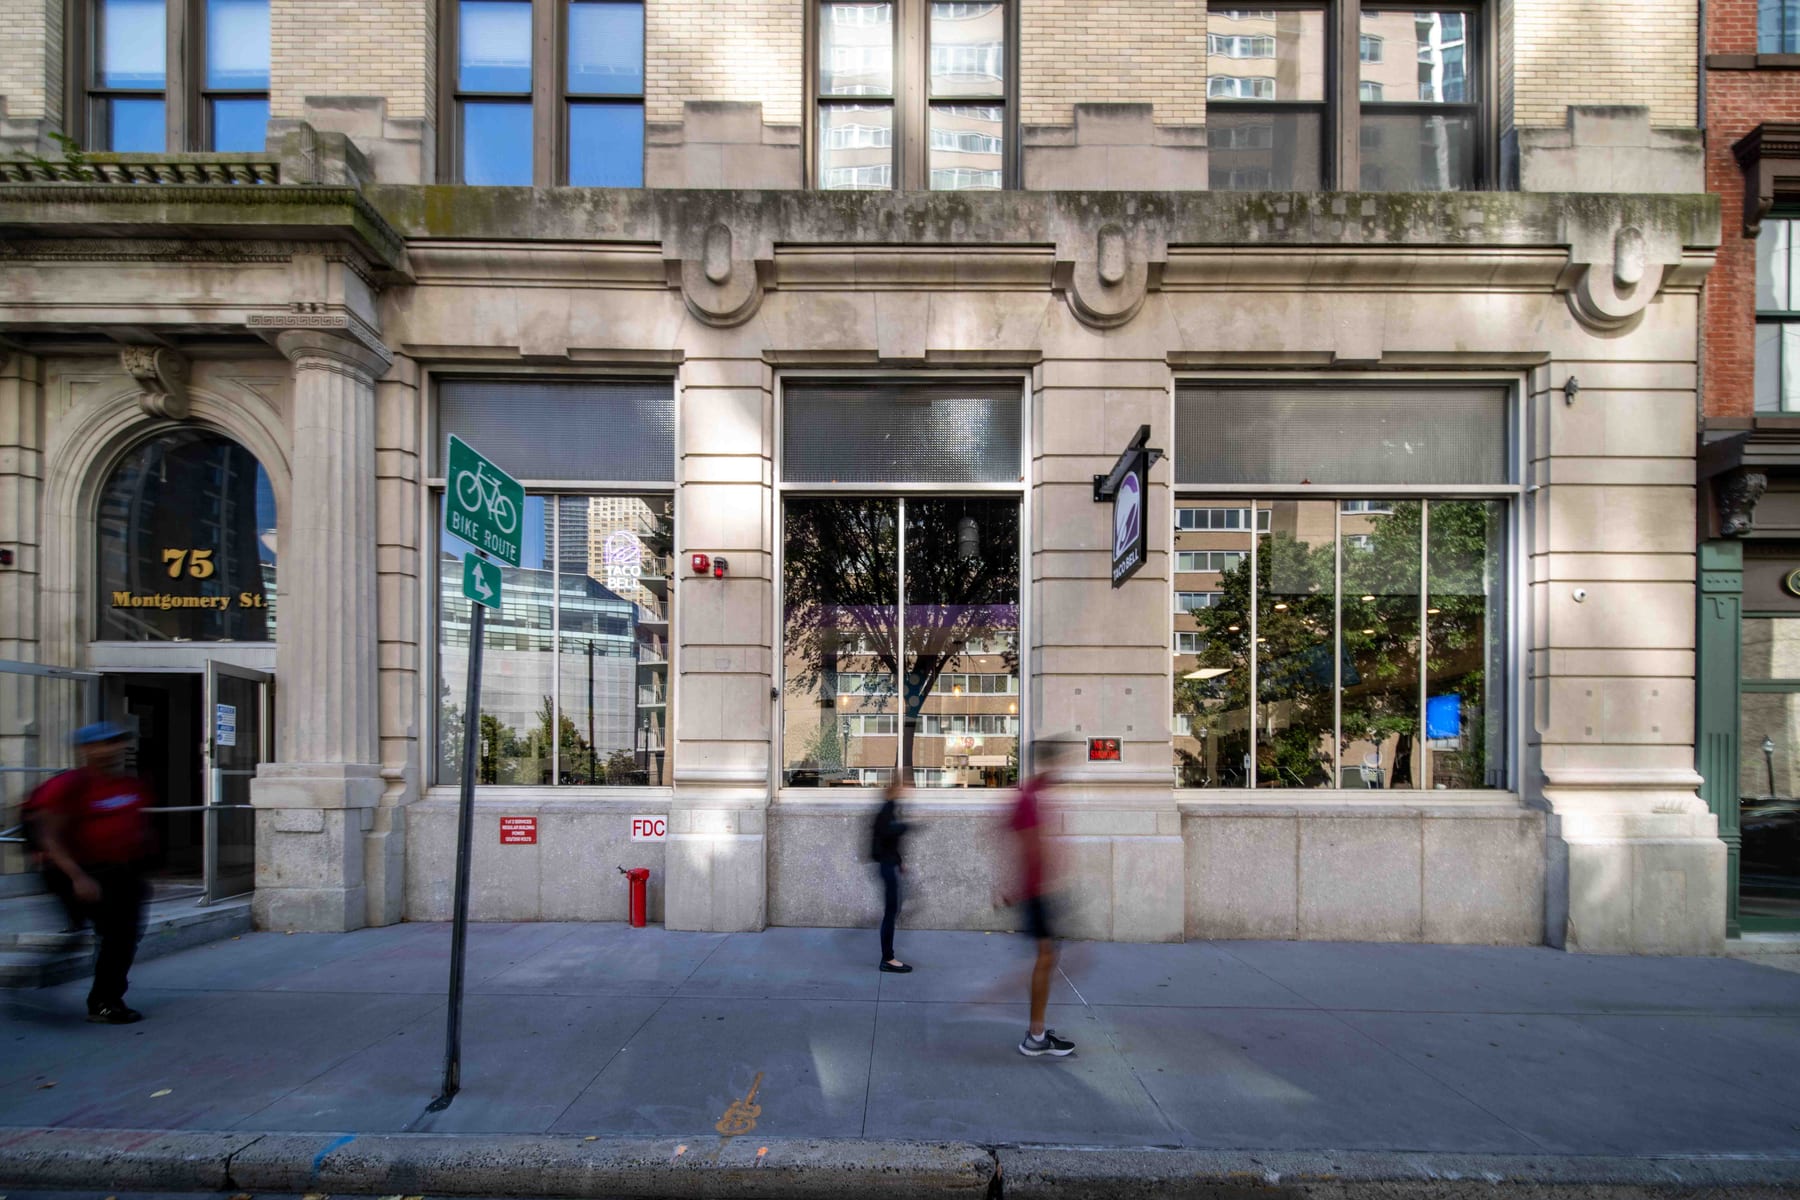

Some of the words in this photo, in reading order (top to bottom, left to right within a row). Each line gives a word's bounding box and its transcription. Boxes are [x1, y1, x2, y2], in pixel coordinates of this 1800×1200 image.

[452, 511, 479, 541] BIKE
[484, 529, 517, 561] ROUTE
[162, 549, 214, 578] 75
[606, 565, 642, 577] TACO
[1113, 560, 1126, 581] TACO
[1125, 547, 1139, 570] BELL
[607, 578, 640, 589] BELL
[112, 591, 231, 610] Montgomery
[239, 592, 268, 608] St.
[633, 819, 665, 837] FDC
